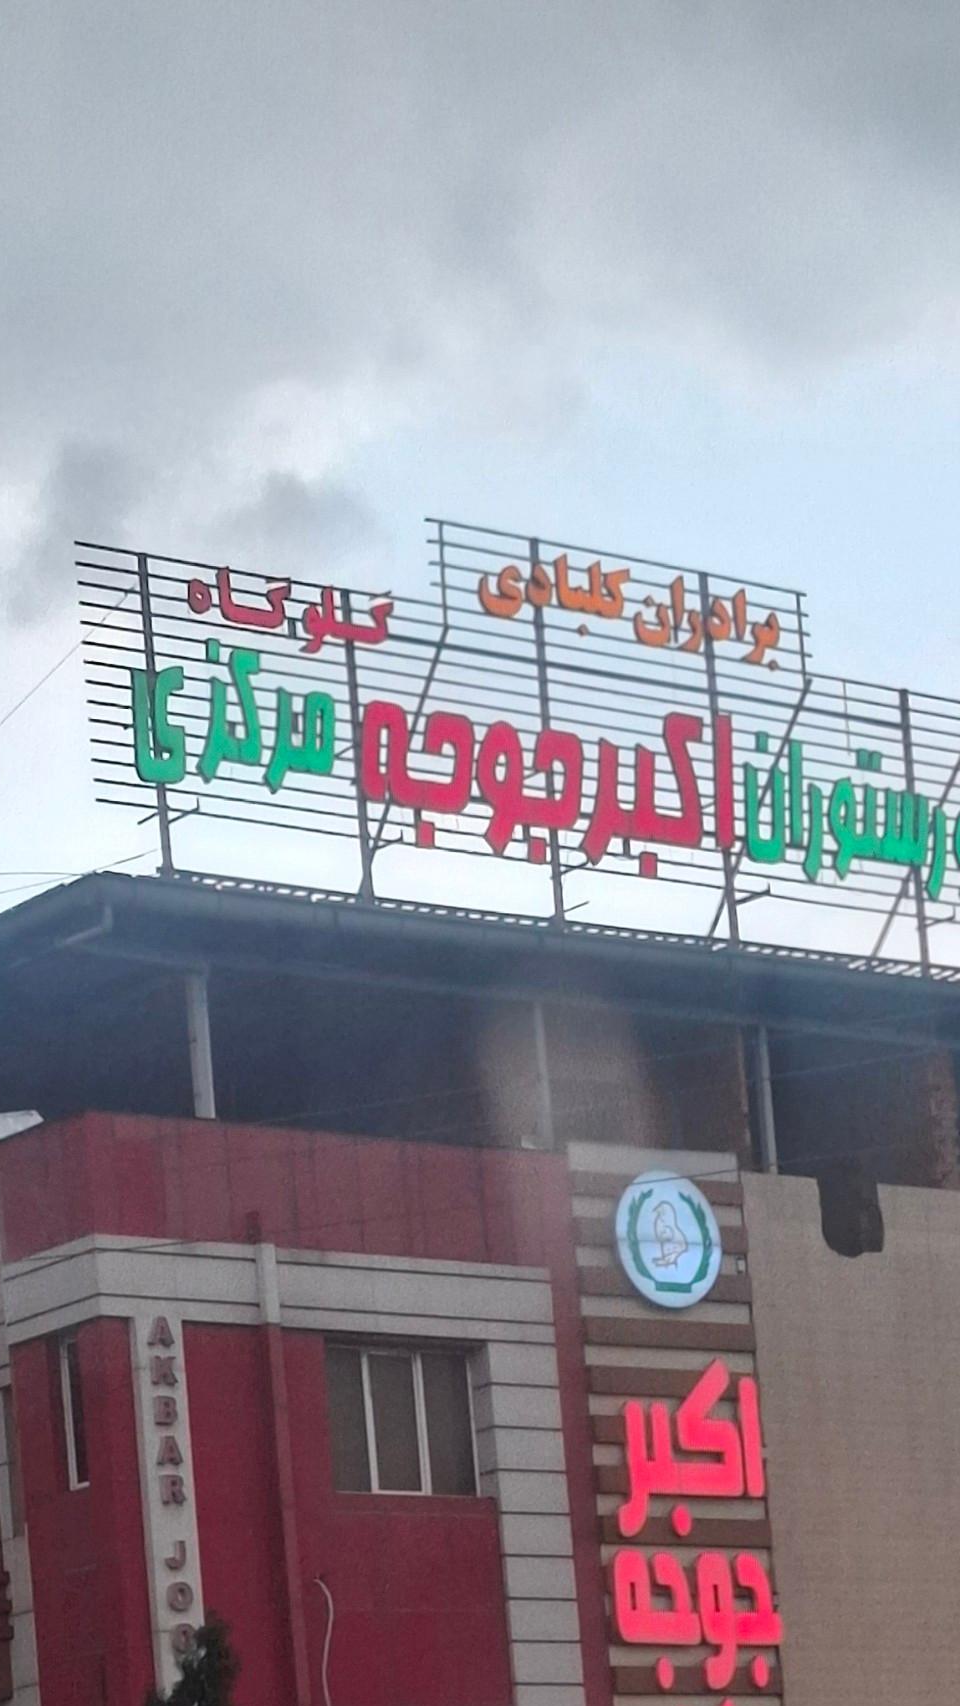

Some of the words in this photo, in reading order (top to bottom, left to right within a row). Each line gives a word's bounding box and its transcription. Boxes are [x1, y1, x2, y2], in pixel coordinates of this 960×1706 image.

[632, 574, 780, 671] برادران
[130, 637, 337, 795] مرکزی
[360, 699, 584, 865] جوجه
[580, 711, 735, 879] اکبر
[743, 730, 947, 903] رستوران
[147, 1315, 188, 1507] AKBAR
[616, 1356, 767, 1538] اکبر
[613, 1550, 784, 1690] جوجه
